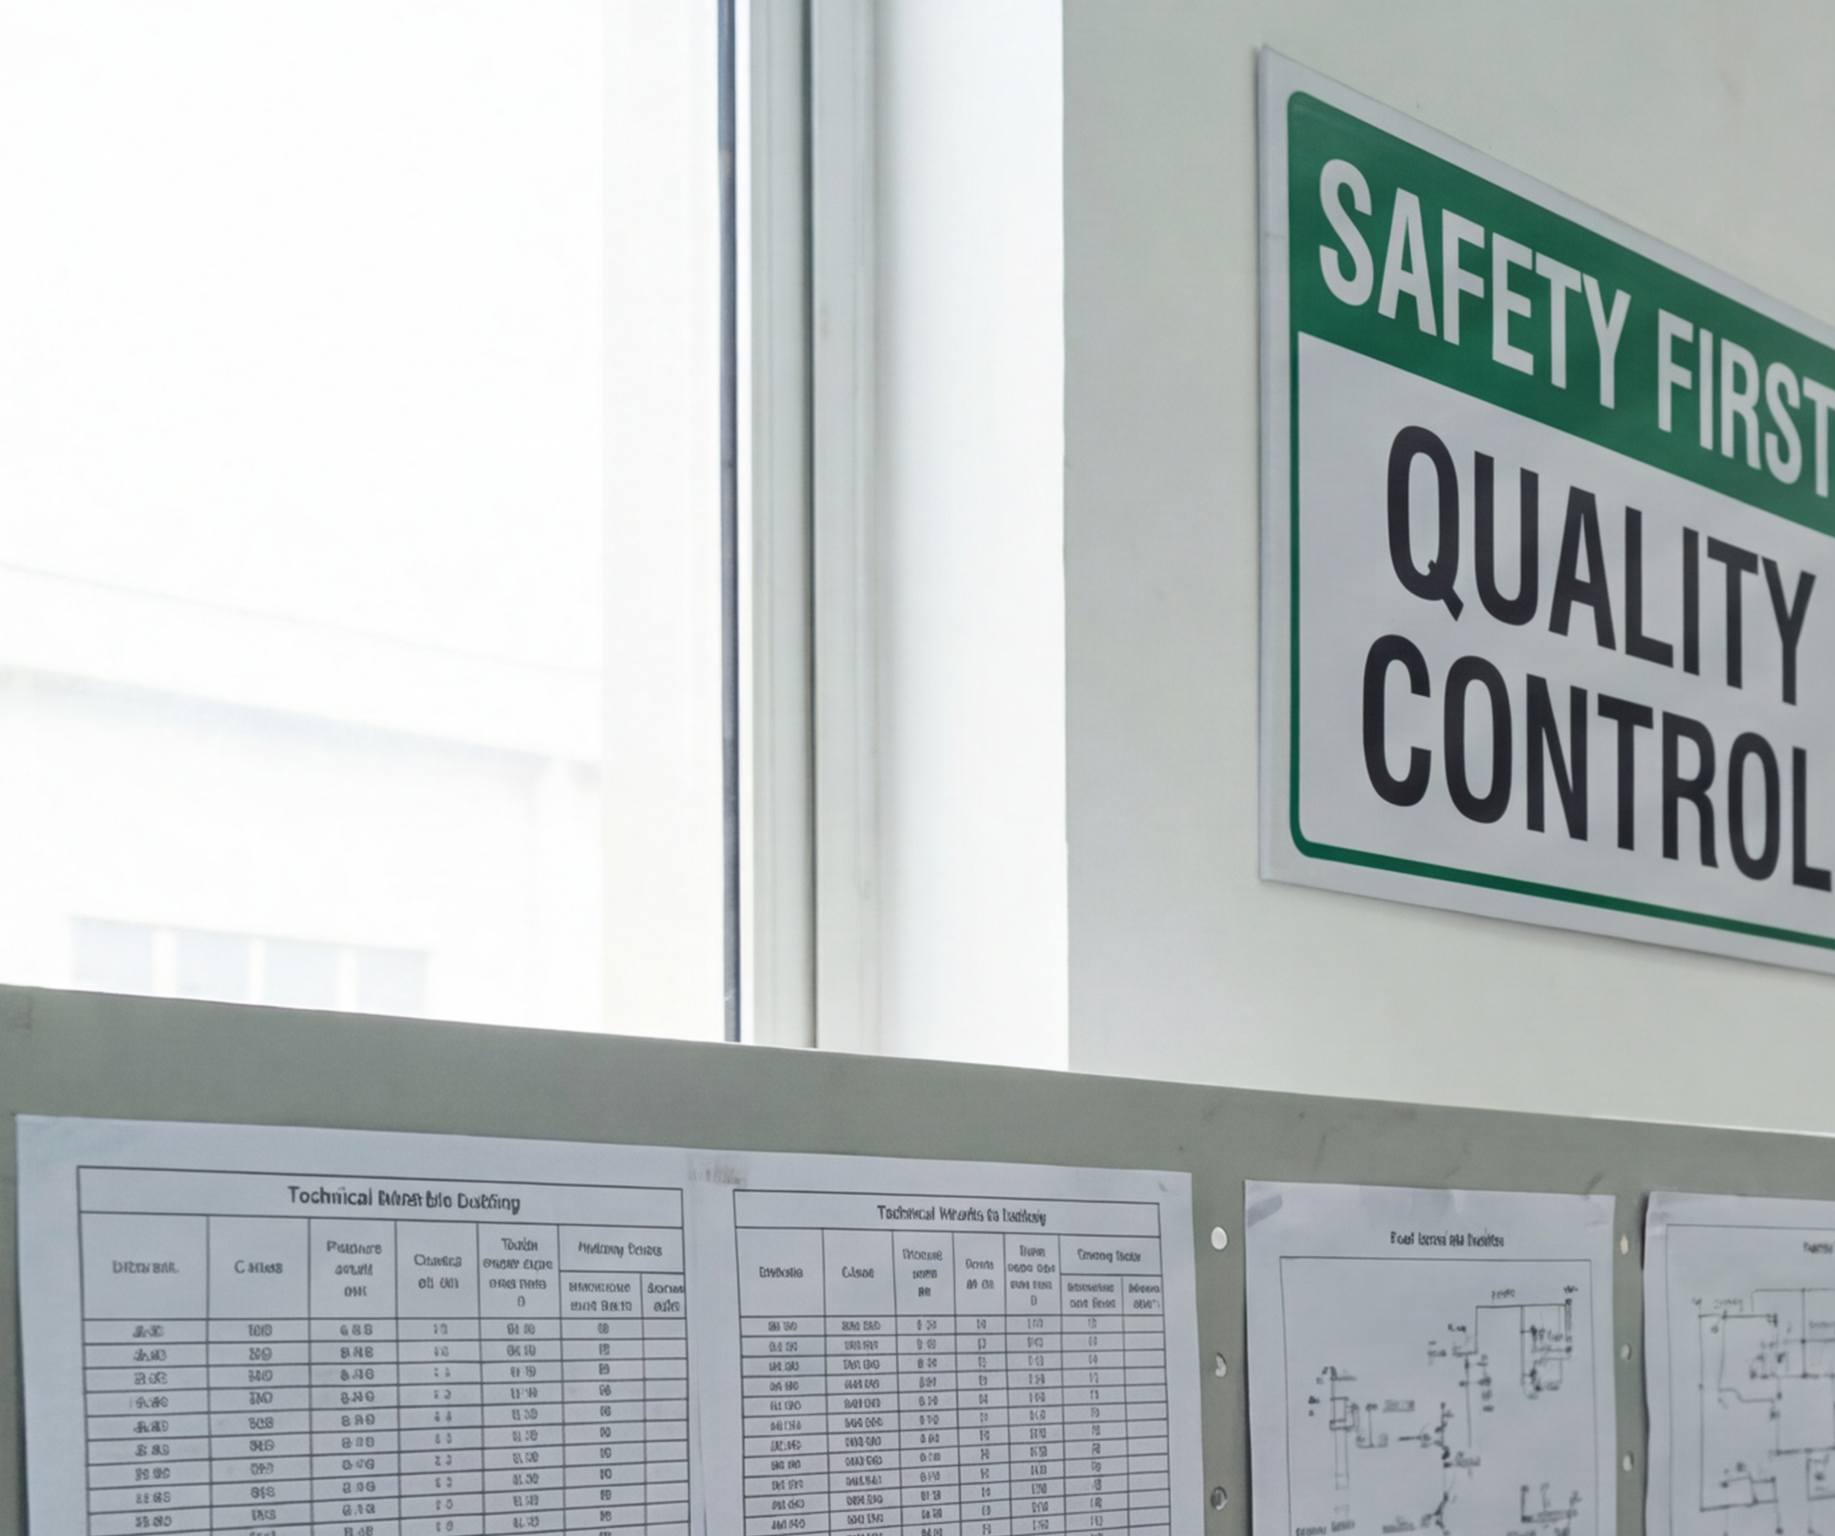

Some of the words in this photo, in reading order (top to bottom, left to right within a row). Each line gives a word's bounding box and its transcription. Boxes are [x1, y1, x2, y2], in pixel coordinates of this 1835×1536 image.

[1318, 158, 1632, 410] SAFETY
[1386, 425, 1817, 707] QUALITY
[1362, 634, 1833, 893] CONTROL
